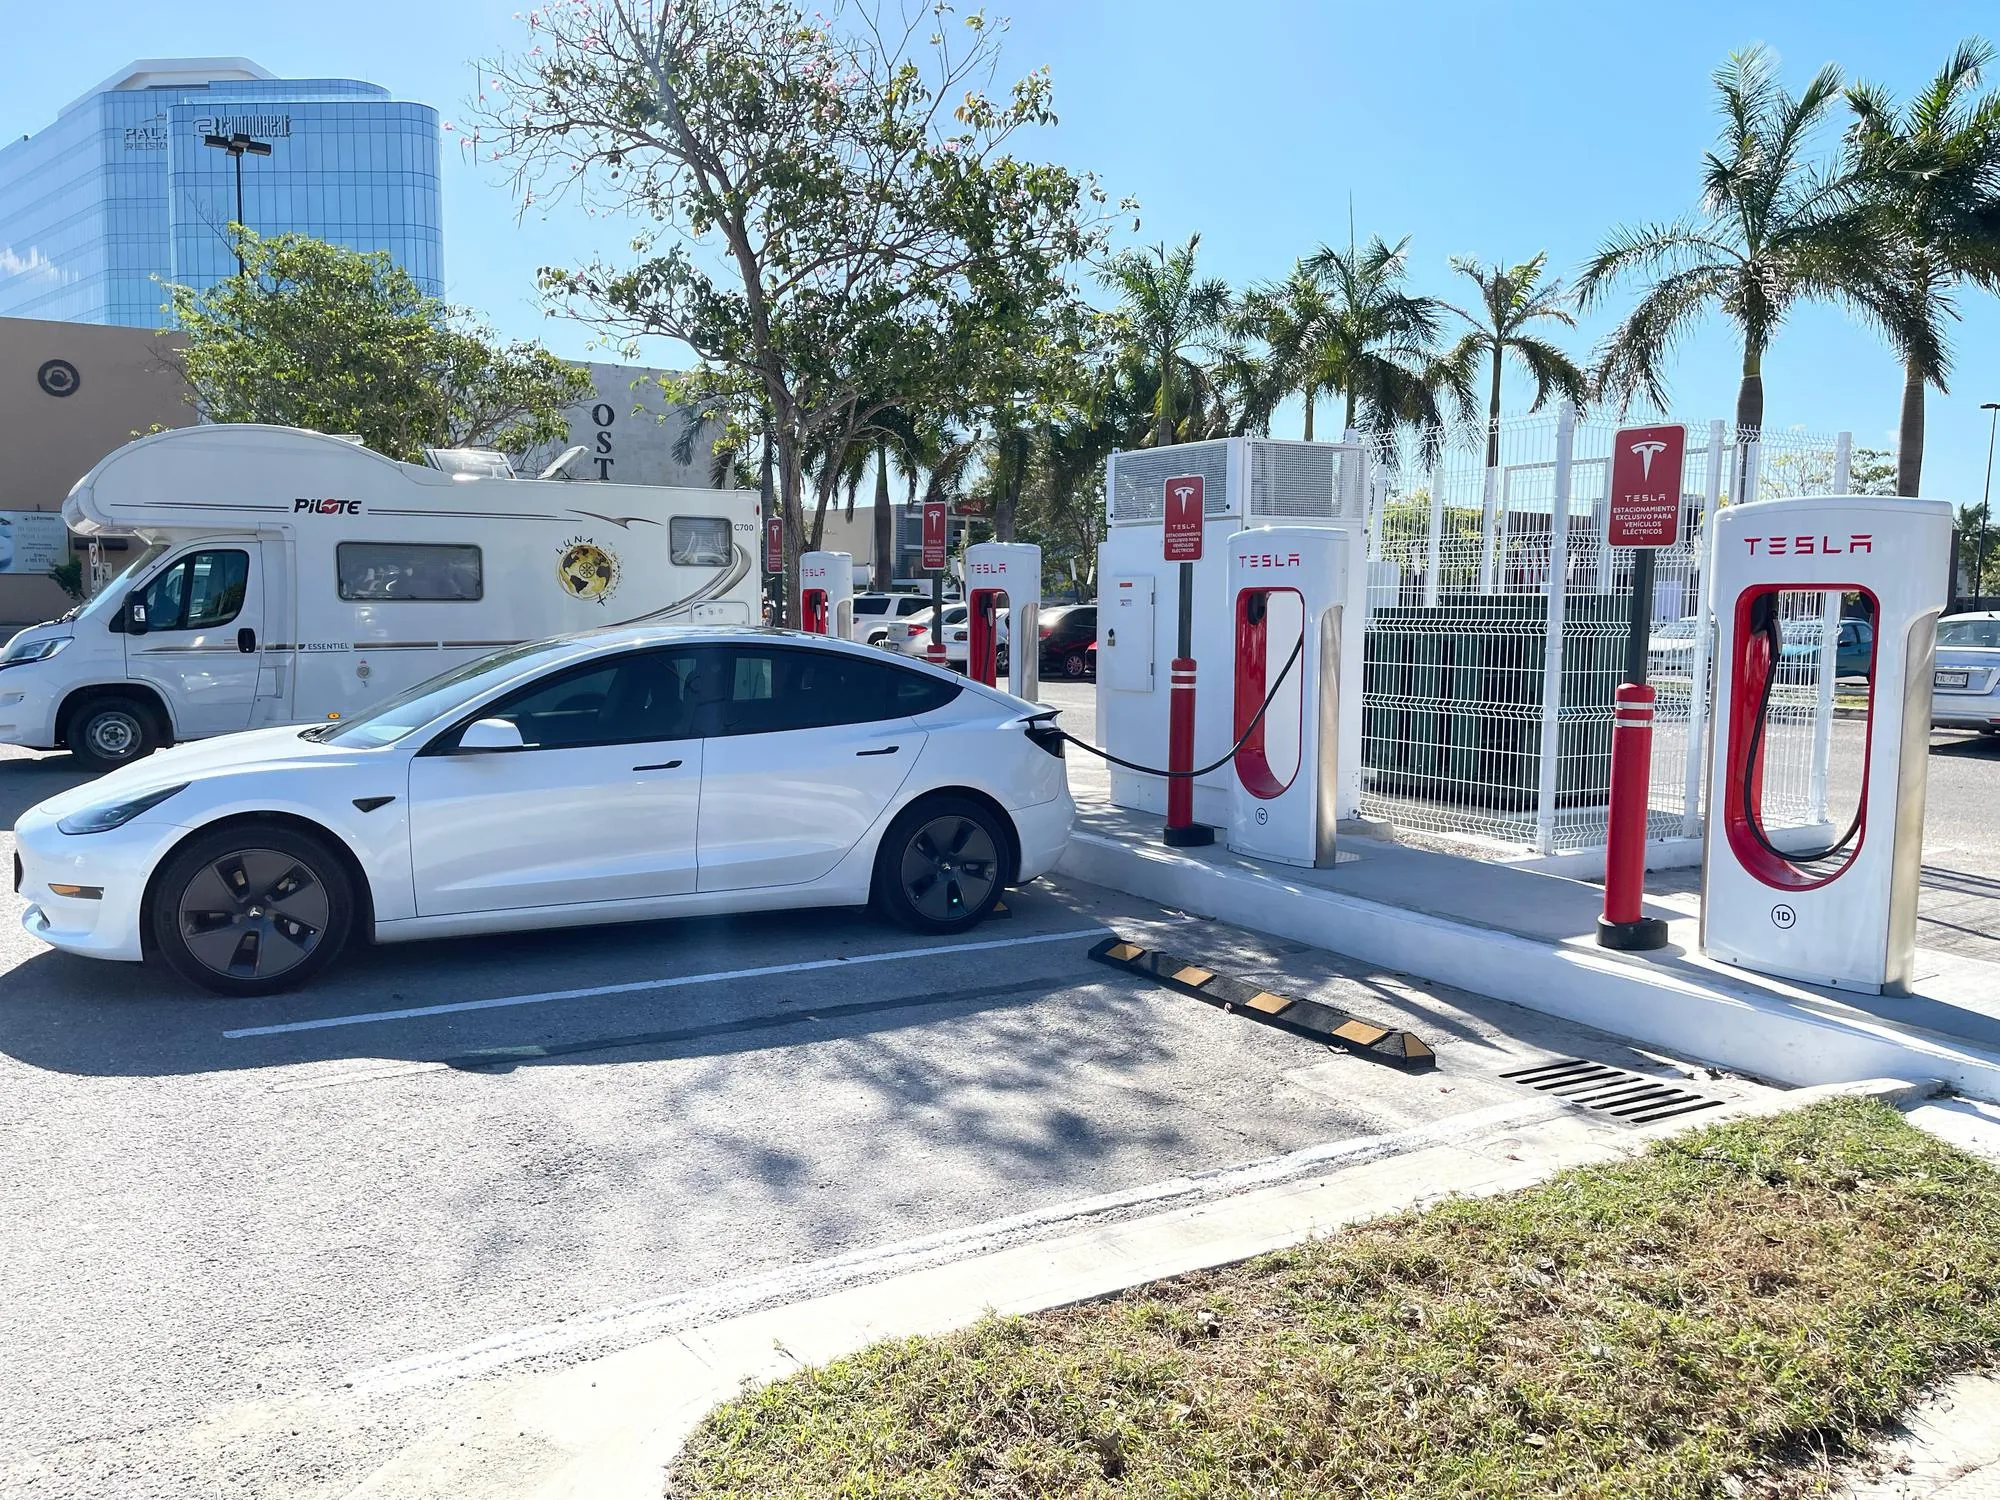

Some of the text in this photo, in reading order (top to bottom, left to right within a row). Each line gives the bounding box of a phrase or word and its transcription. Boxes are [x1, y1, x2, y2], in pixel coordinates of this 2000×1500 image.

[592, 403, 615, 480] OST
[1625, 494, 1666, 502] TESLA
[1624, 520, 1662, 528] VEHÍCULOS
[1744, 534, 1873, 556] TESLA
[1239, 553, 1300, 568] TESLA
[801, 568, 826, 577] TESLA
[970, 563, 1006, 573] TESLA
[308, 642, 350, 650] ESSENTIEL
[1775, 910, 1791, 921] 1D
